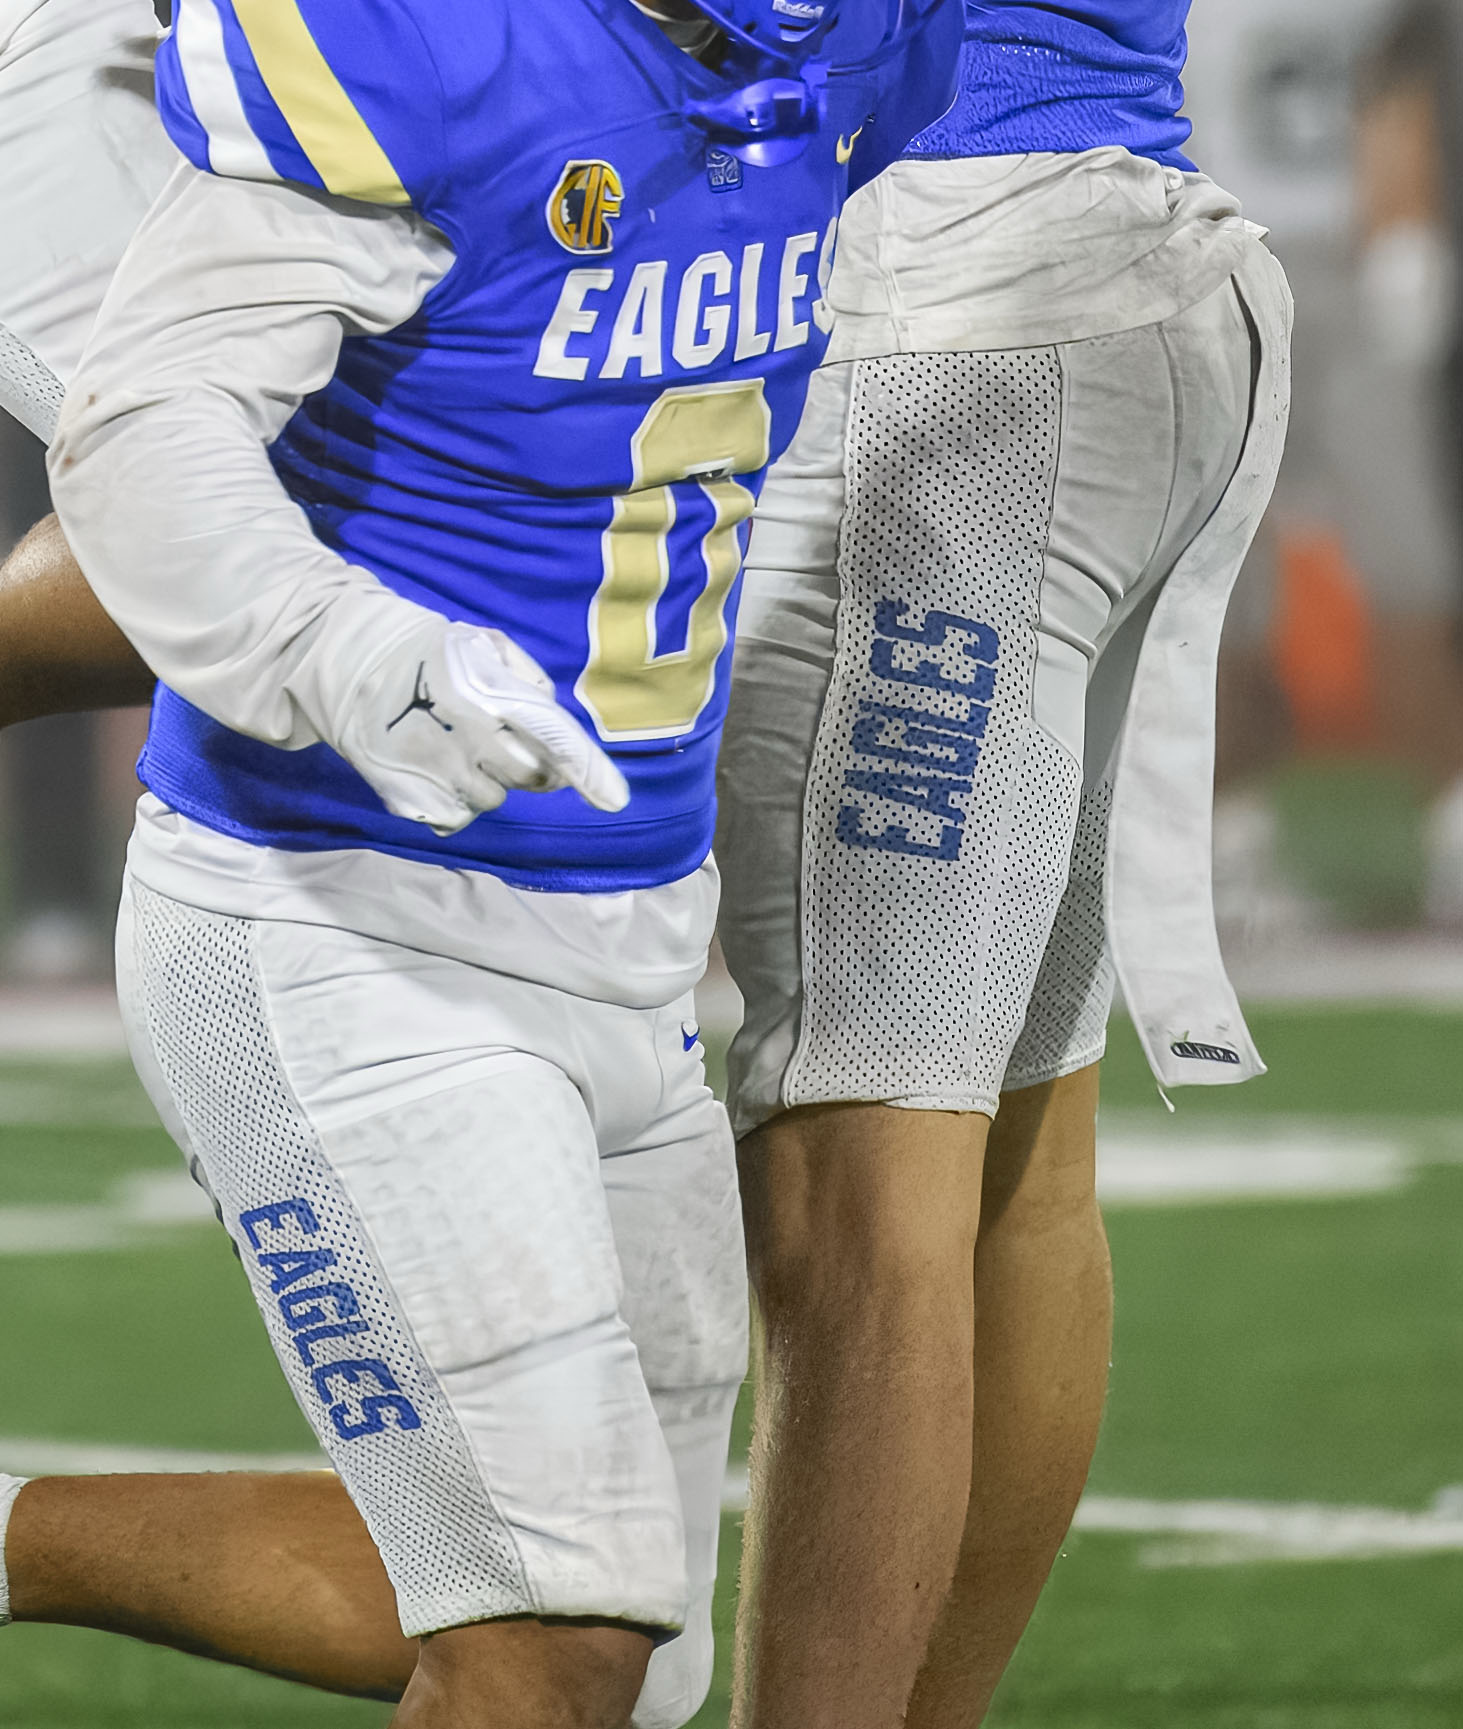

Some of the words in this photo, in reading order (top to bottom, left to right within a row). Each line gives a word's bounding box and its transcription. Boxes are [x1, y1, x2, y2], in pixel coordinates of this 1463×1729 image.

[549, 163, 622, 249] CIF
[574, 377, 772, 742] 0
[835, 596, 1000, 862] EAGLES
[239, 1197, 422, 1441] EAGLES
